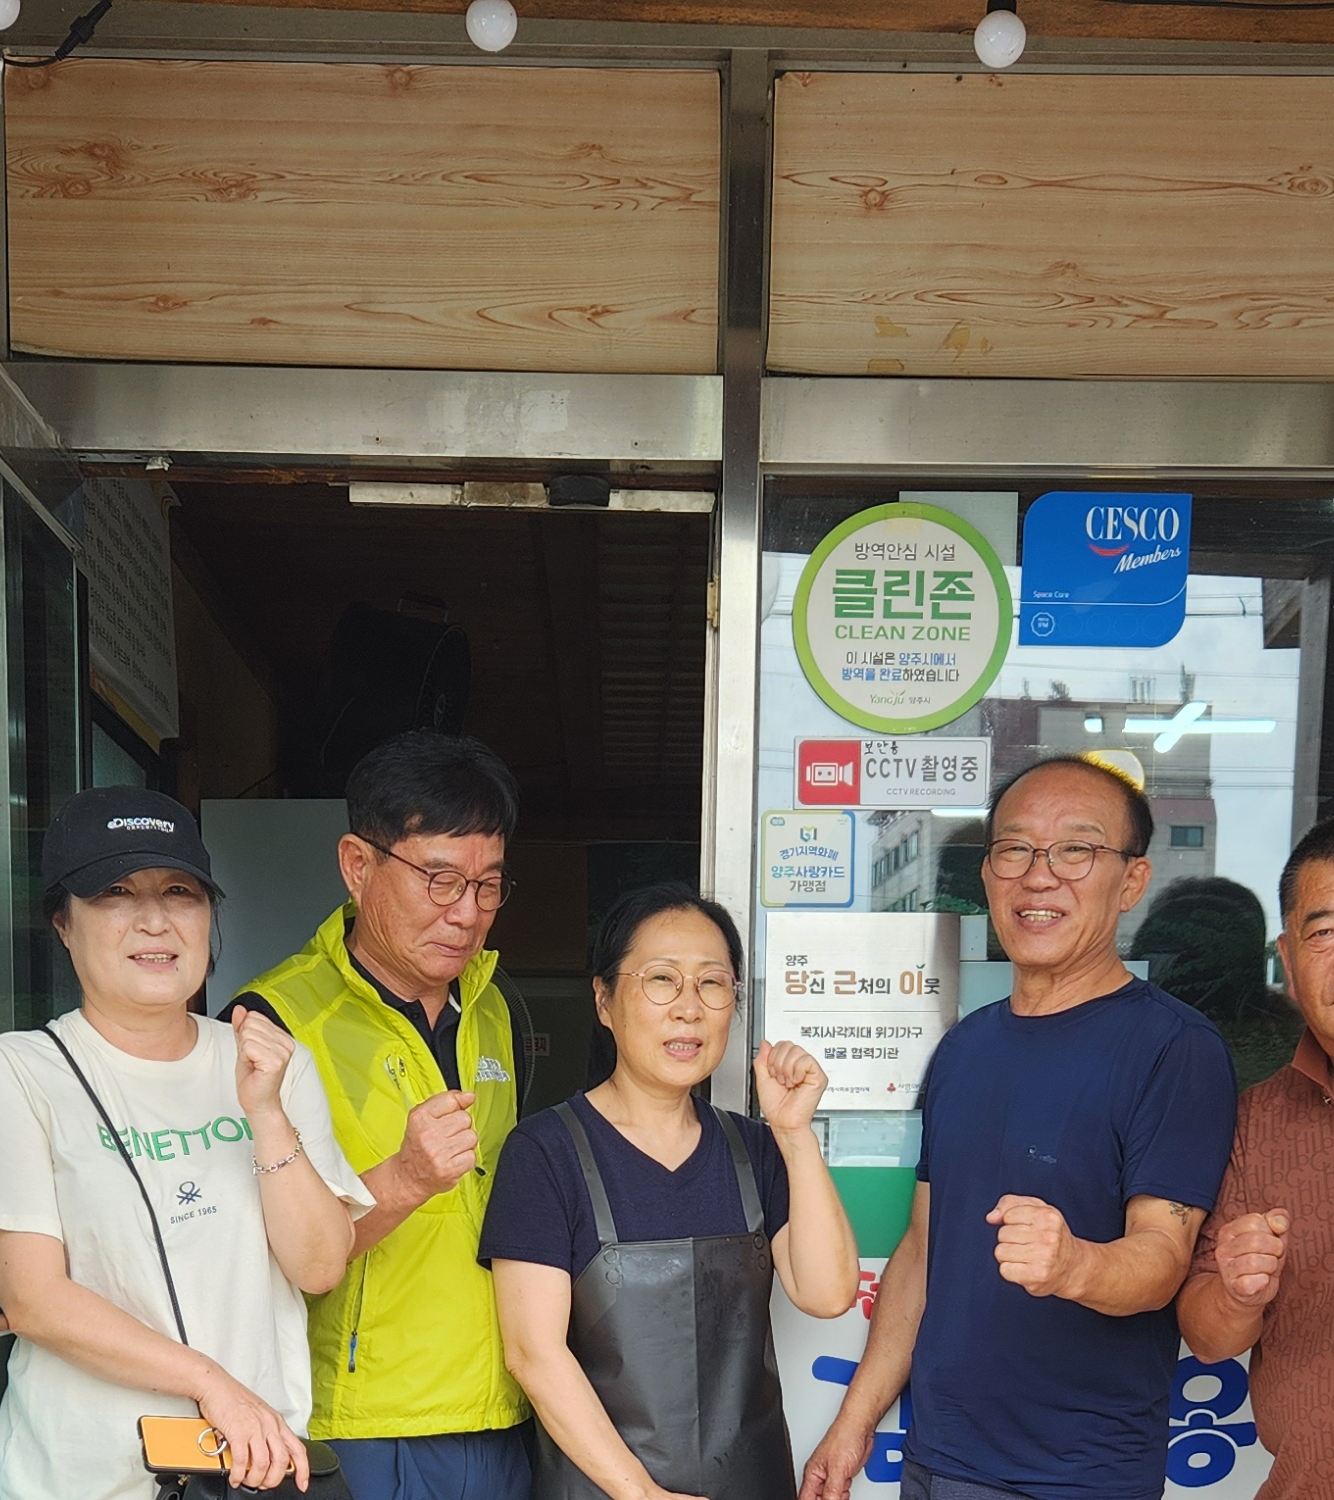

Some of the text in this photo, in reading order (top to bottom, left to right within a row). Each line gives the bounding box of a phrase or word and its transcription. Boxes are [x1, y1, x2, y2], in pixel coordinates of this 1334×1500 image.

[1085, 506, 1180, 542] CESCO
[854, 543, 955, 561] 방역안심 시설
[1113, 544, 1182, 575] Members
[832, 569, 975, 620] 클린존
[835, 625, 971, 641] CLEAN ZONE
[846, 652, 956, 666] 이 시설은 양주시에서
[842, 668, 959, 682] 방역을 완료하였습니다
[866, 756, 978, 782] CCTV 촬영중
[910, 788, 956, 796] RECORDING
[771, 866, 845, 878] 양주사랑카드
[790, 880, 826, 893] 가맹점
[785, 955, 808, 966] 양주
[785, 969, 941, 995] 당신 근처의 이웃
[801, 1026, 923, 1039] 복지사각지대 위기가구
[824, 1047, 899, 1060] 발굴 협력기관
[170, 1206, 217, 1224] SINCE 1965
